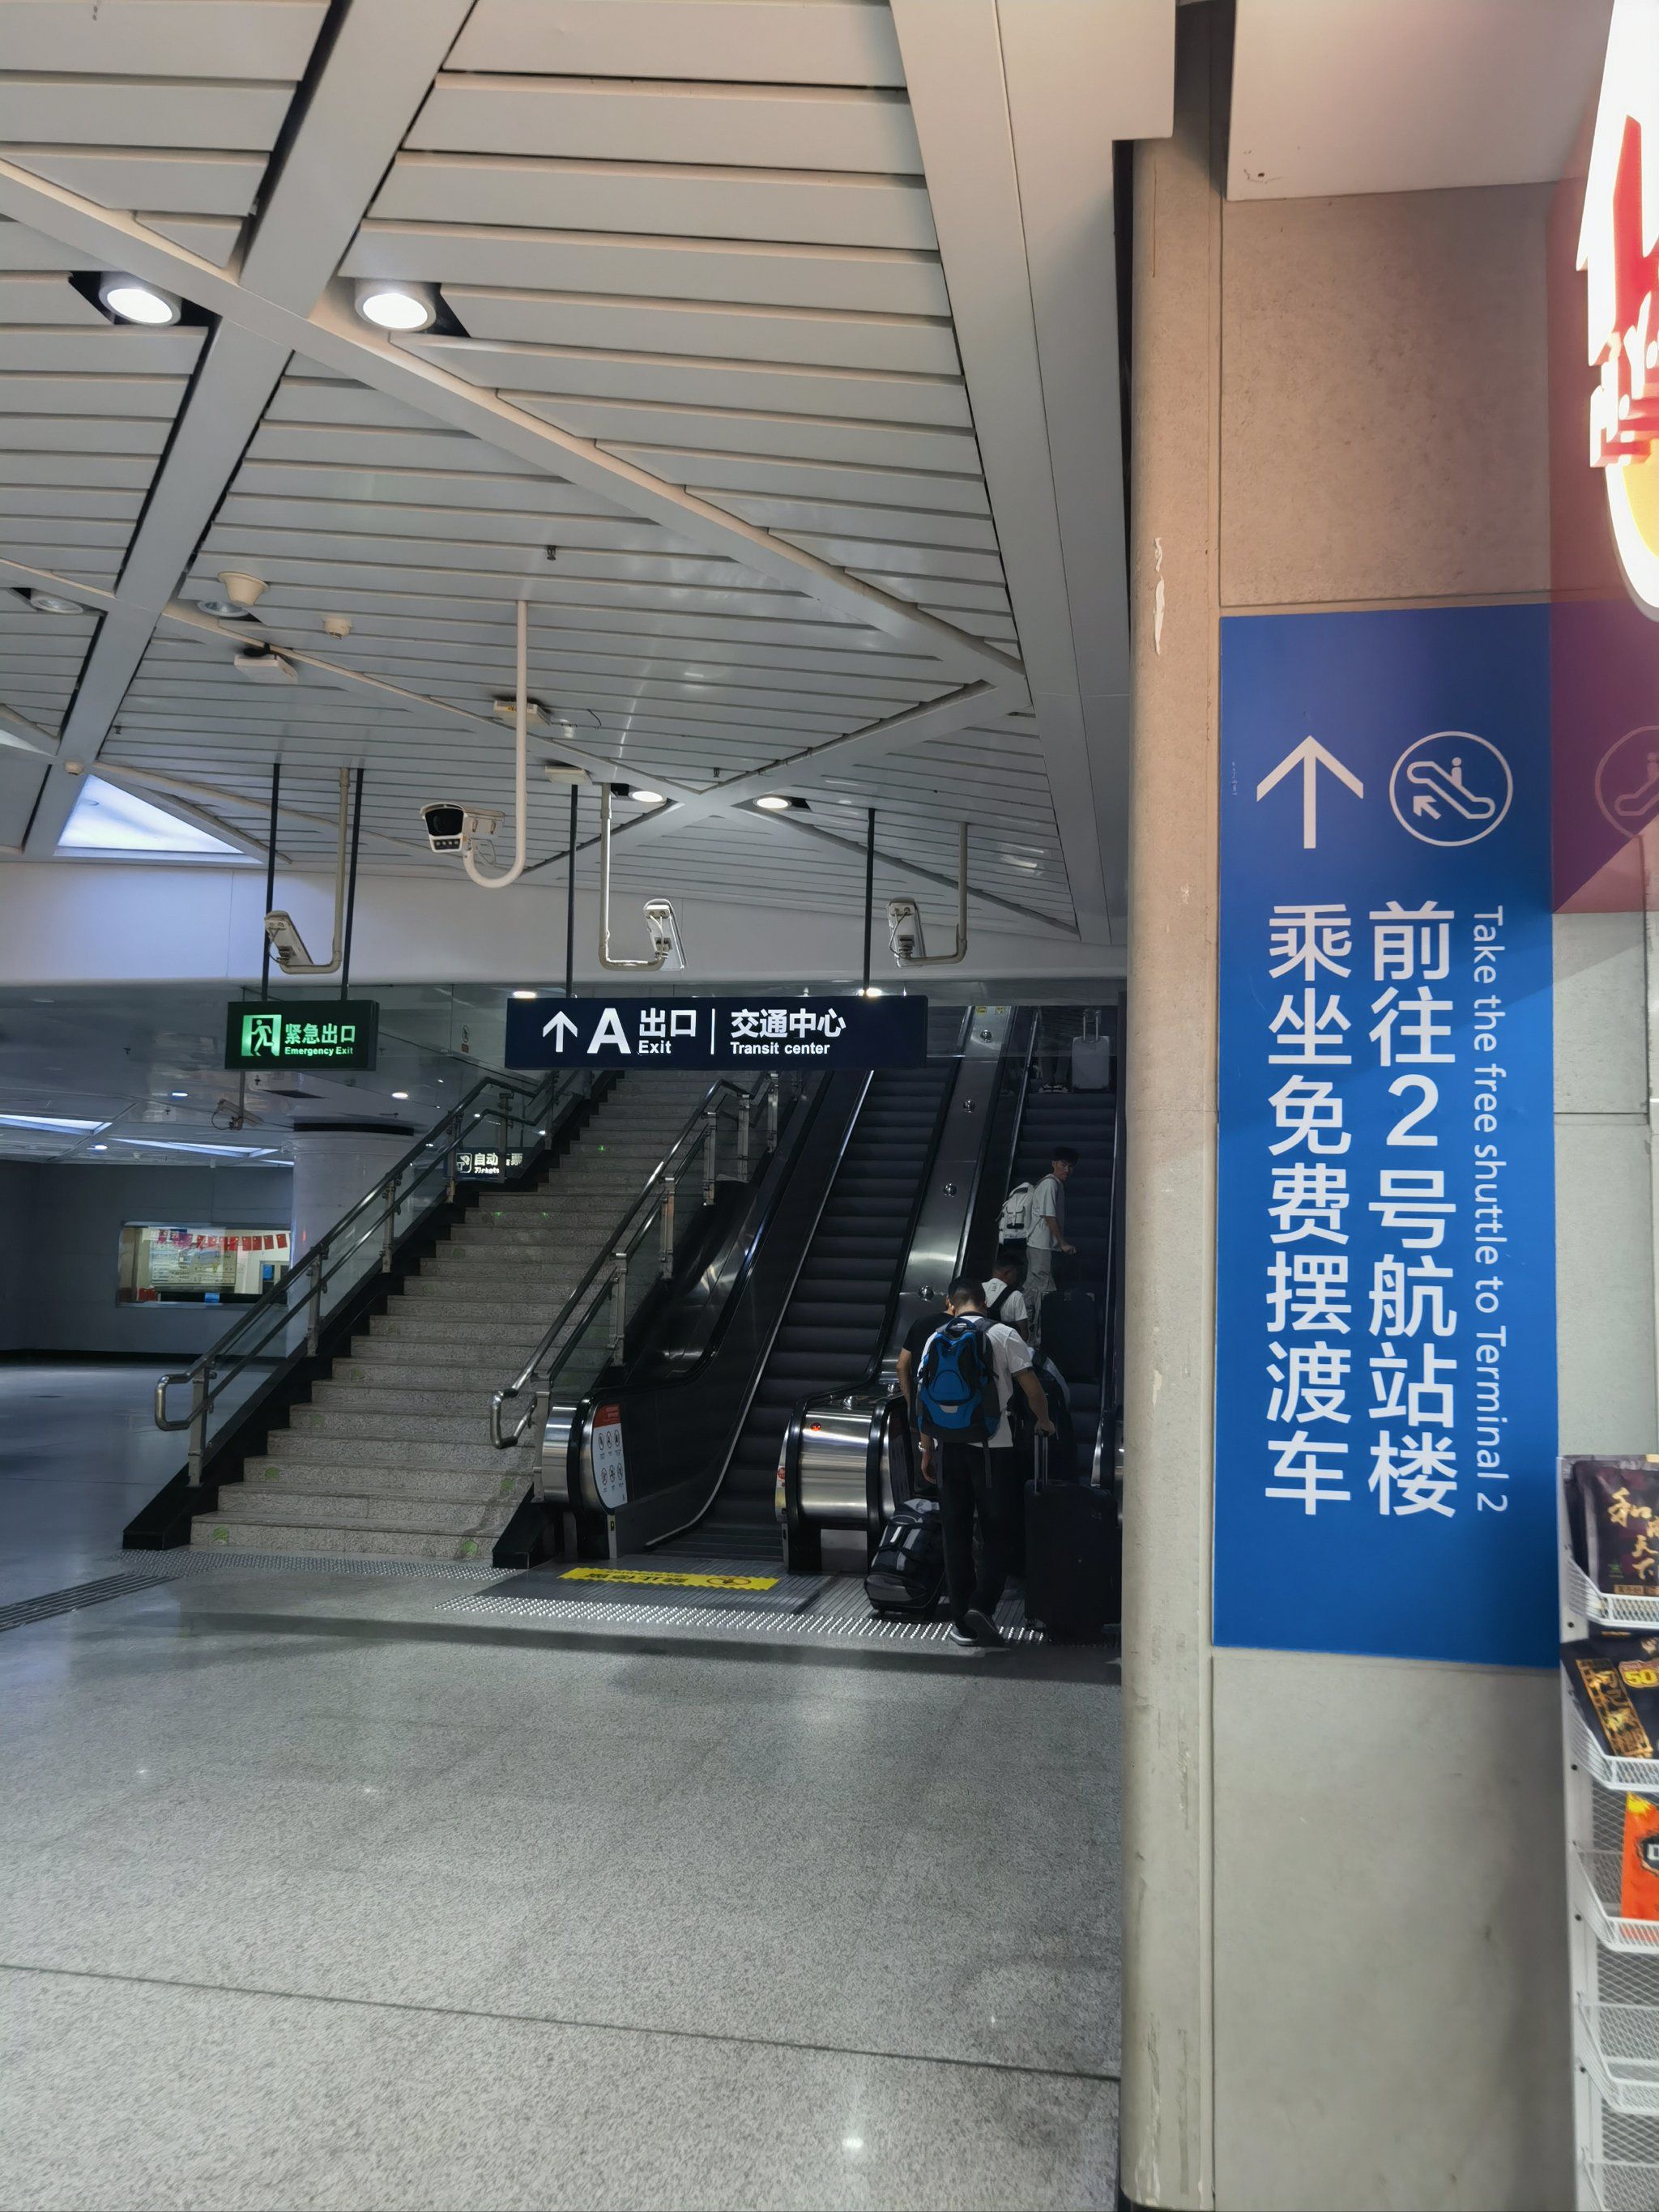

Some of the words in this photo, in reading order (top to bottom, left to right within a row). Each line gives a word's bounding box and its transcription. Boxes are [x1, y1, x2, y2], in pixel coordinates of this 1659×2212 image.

[1473, 906, 1505, 983] Take
[284, 1023, 356, 1045] 紧急出口
[586, 1008, 632, 1055] A
[639, 1008, 697, 1038] 出口
[731, 1008, 847, 1038] 交通中心
[1473, 995, 1506, 1051] the
[284, 1046, 334, 1056] Emergency
[335, 1046, 353, 1055] Exit
[638, 1040, 672, 1055] Exit
[730, 1042, 780, 1055] Transit
[784, 1042, 831, 1055] center
[1473, 1063, 1507, 1132] free
[1265, 904, 1352, 1515] 乘坐免费摆渡车
[1369, 901, 1457, 1518] 前往2号航站楼
[1474, 1144, 1508, 1264] shuttle
[1475, 1276, 1503, 1313] to
[1476, 1325, 1509, 1479] Terminal
[1477, 1494, 1508, 1511] 2
